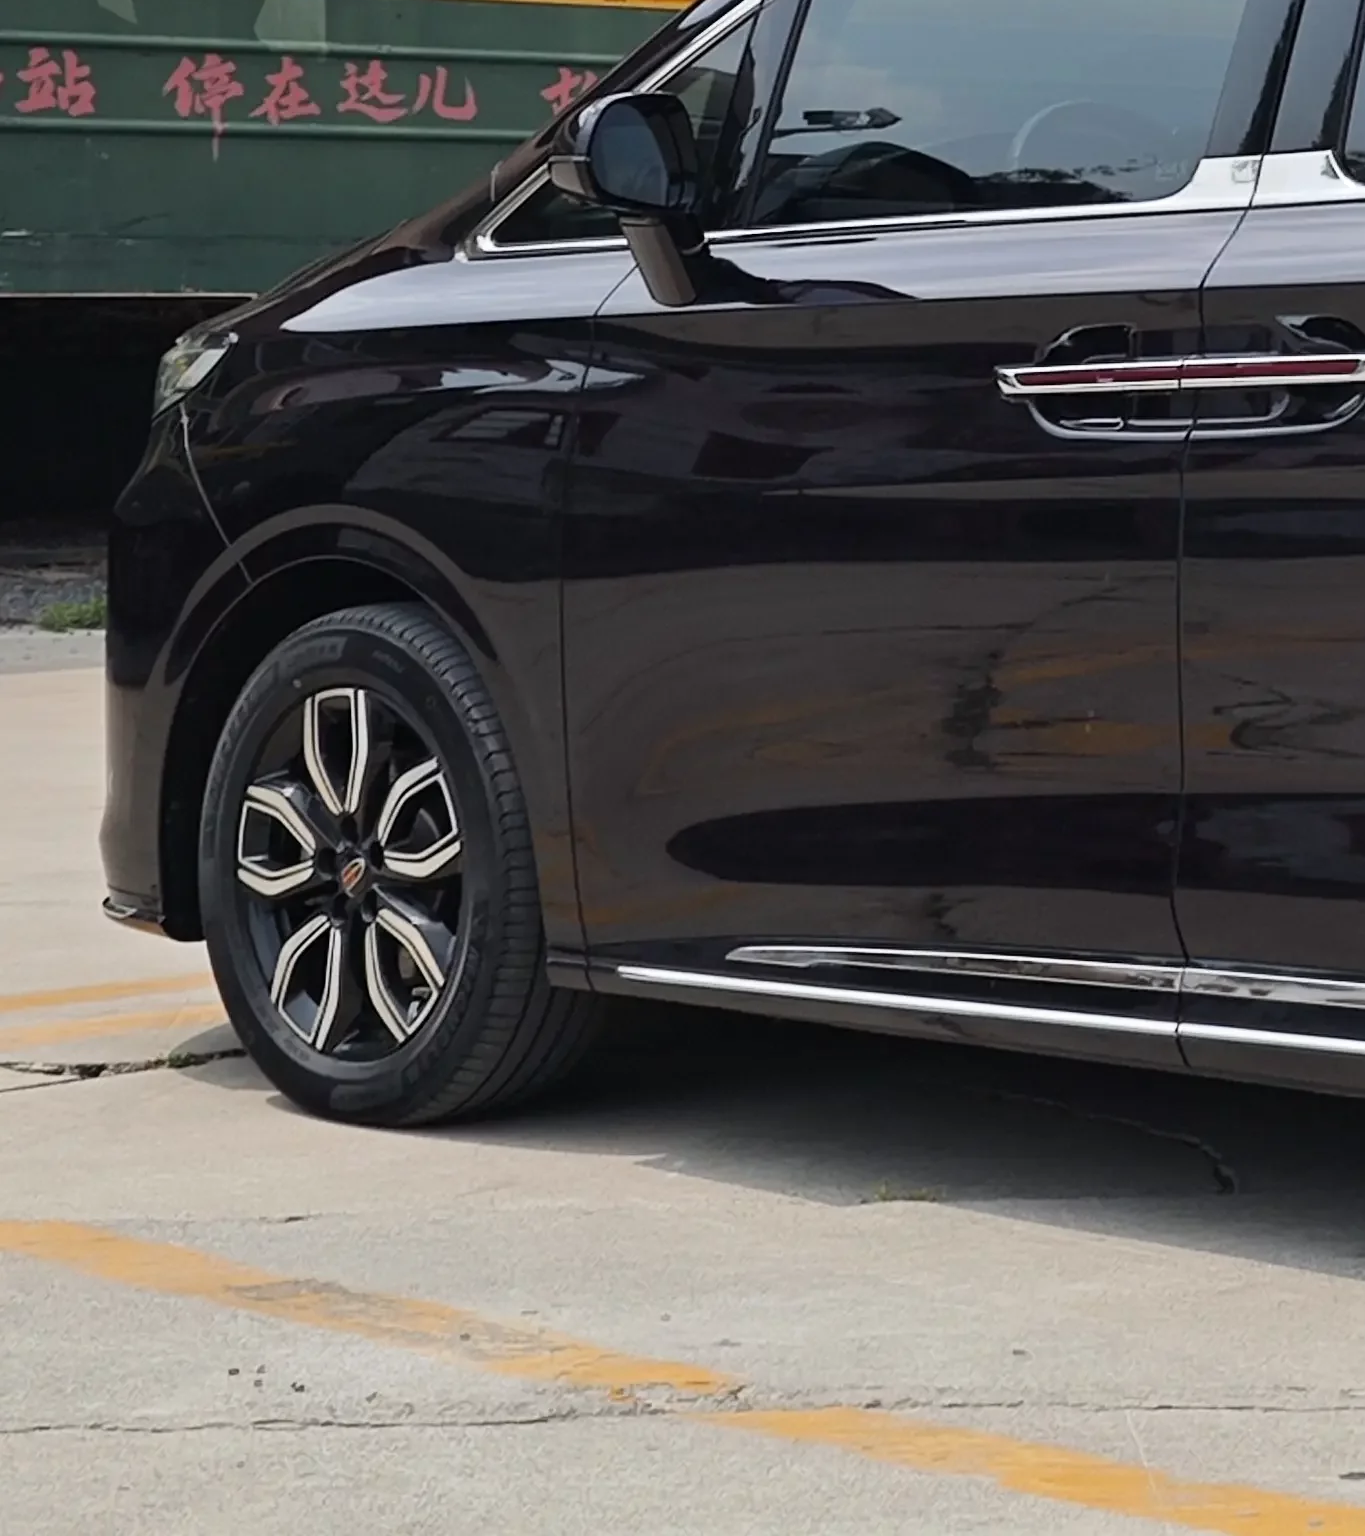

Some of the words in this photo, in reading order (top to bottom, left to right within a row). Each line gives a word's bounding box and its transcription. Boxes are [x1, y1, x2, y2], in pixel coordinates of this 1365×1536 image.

[0, 46, 96, 118] 站
[163, 52, 478, 136] 停在这儿
